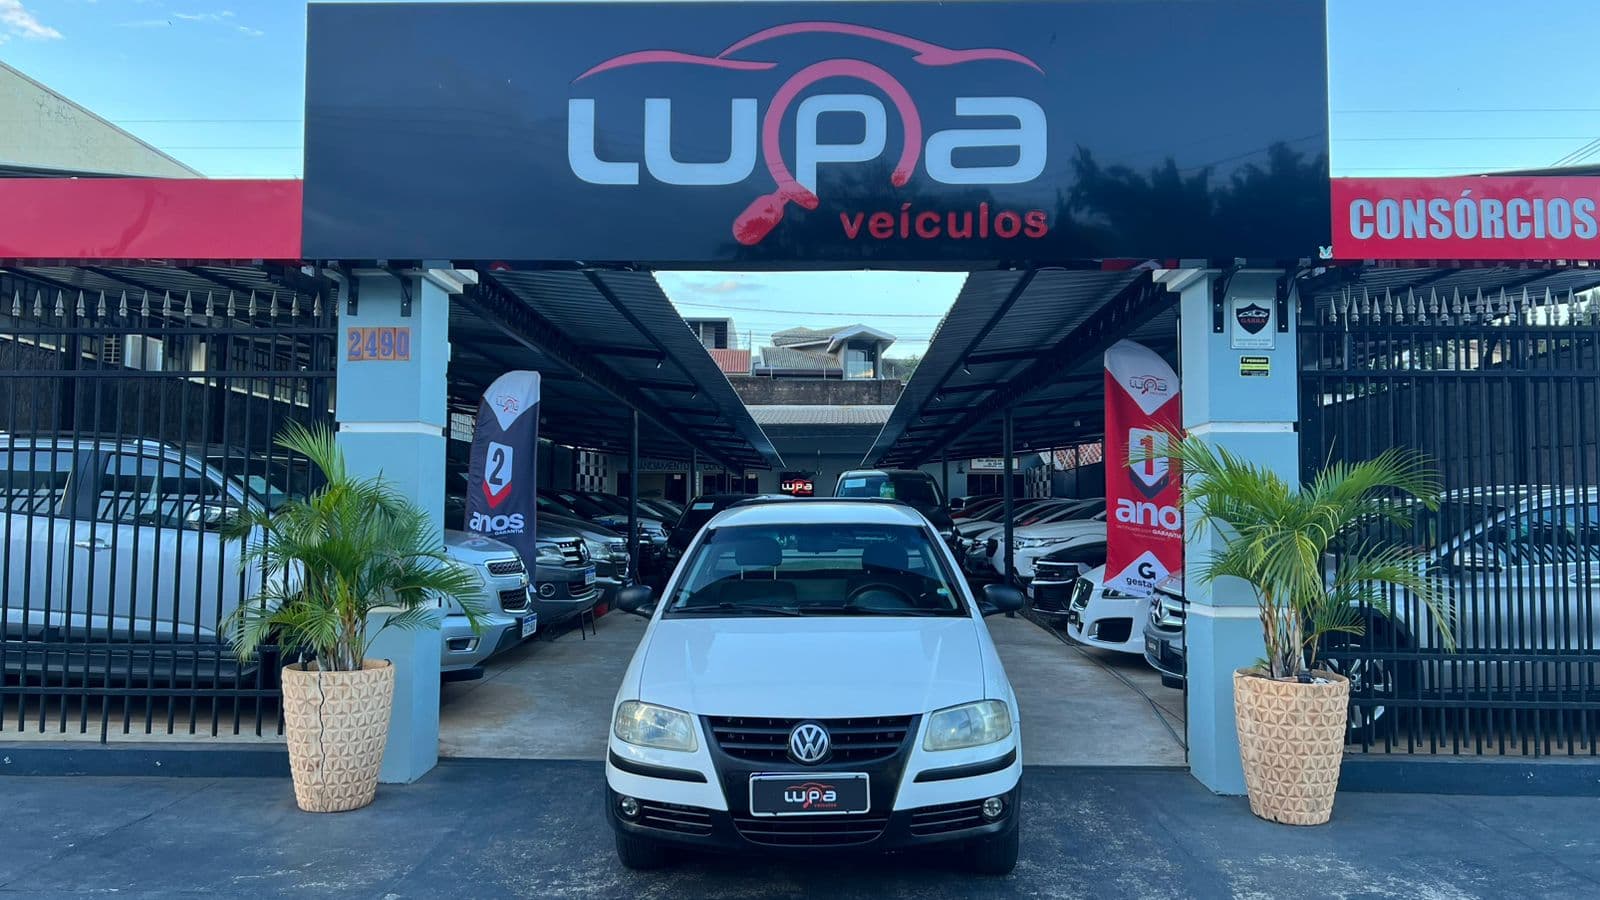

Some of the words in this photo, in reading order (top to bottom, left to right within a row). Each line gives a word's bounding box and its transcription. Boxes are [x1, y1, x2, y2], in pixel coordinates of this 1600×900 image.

[840, 203, 1049, 240] veículos
[1349, 189, 1598, 240] CONSÓRCIOS
[347, 330, 410, 358] 2490
[489, 448, 505, 486] 2
[1140, 434, 1154, 475] 1
[469, 511, 525, 533] anos
[1126, 577, 1154, 589] gesta
